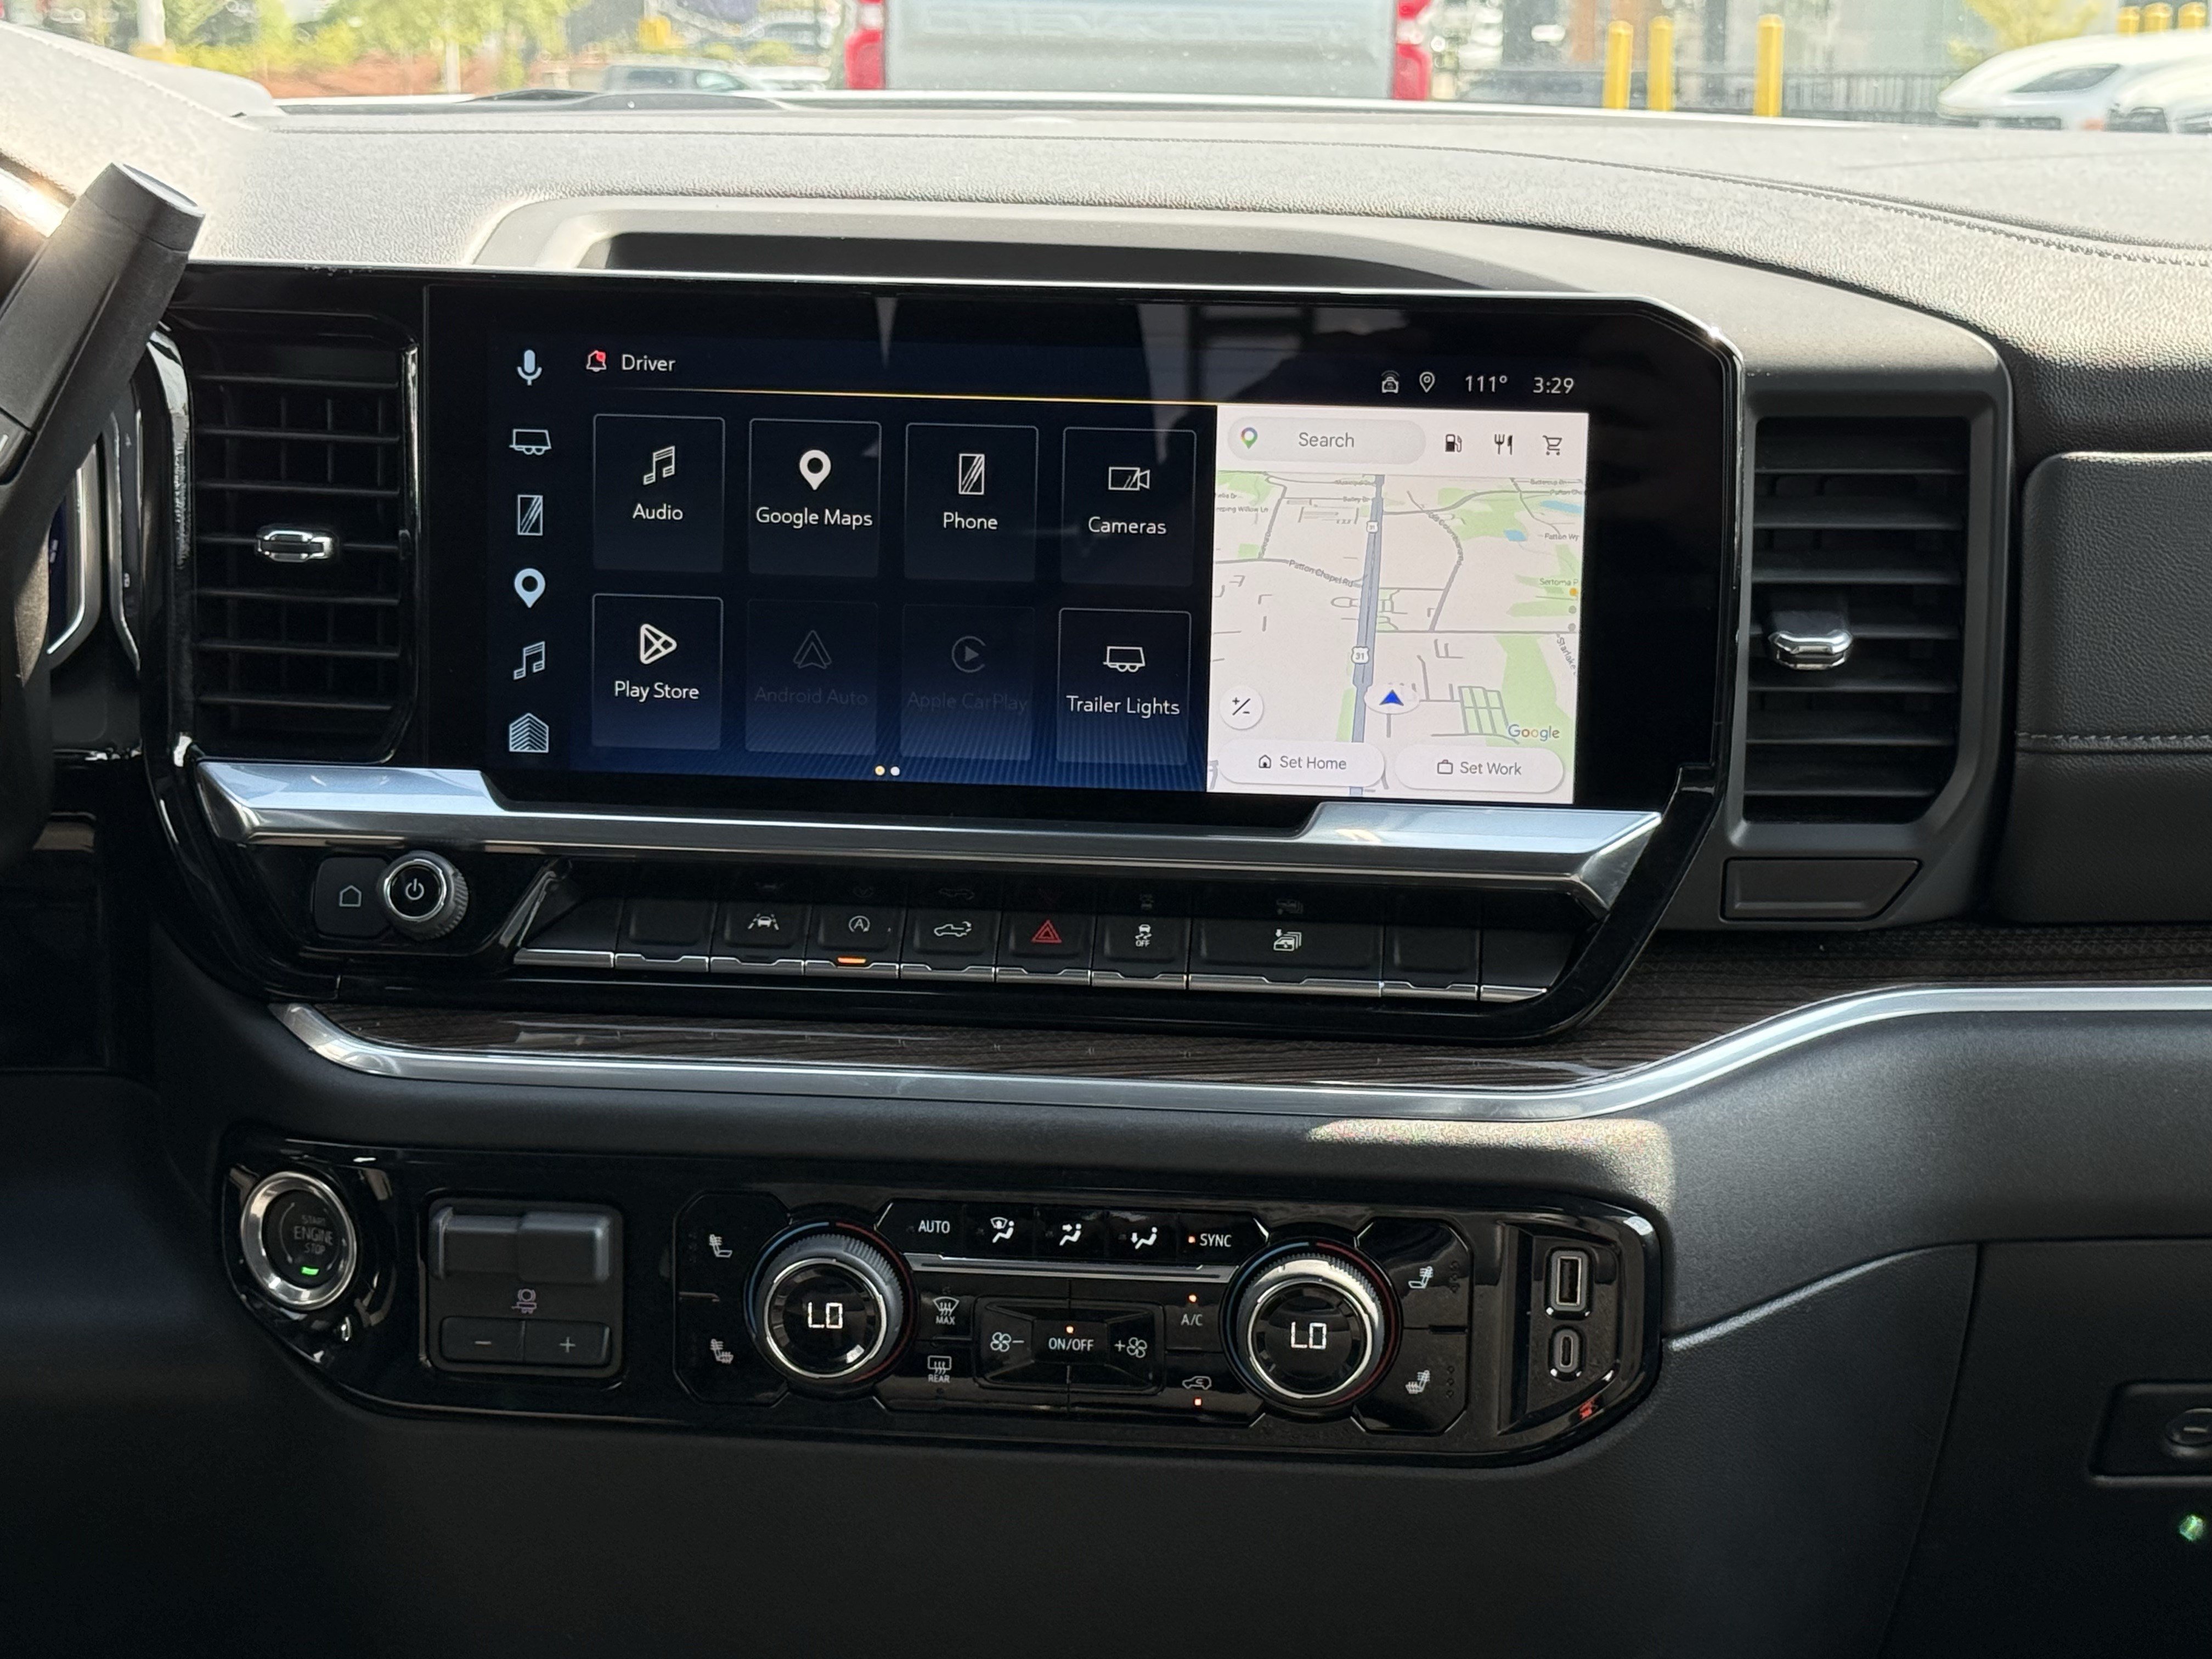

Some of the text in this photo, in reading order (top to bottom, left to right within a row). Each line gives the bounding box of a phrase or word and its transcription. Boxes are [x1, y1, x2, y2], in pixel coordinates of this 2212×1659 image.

[622, 354, 675, 373] Driver
[1465, 376, 1508, 392] 111°
[1533, 377, 1575, 394] 3:29
[1298, 432, 1355, 448] Search
[633, 504, 683, 521] Audio
[756, 507, 873, 530] Google Maps
[943, 512, 998, 530] Phone
[1088, 516, 1166, 535] Cameras
[1356, 652, 1365, 661] 31
[614, 680, 699, 703] Play Store
[754, 687, 867, 706] Android Auto
[907, 691, 1028, 713] Apple CarPlay
[1066, 695, 1181, 719] Trailer Lights
[1508, 724, 1560, 741] Google
[1279, 756, 1347, 770] Set Home
[1459, 761, 1522, 776] Set Work
[1136, 939, 1151, 947] OFF
[918, 1221, 950, 1234] AUTO
[304, 1243, 326, 1255] STOP
[1199, 1234, 1232, 1248] SYNC
[808, 1302, 843, 1329] LO
[935, 1317, 956, 1325] MAX
[1181, 1314, 1203, 1327] A/C
[1291, 1322, 1327, 1350] LO
[1048, 1338, 1094, 1352] ON/OFF
[928, 1374, 950, 1383] REAR
